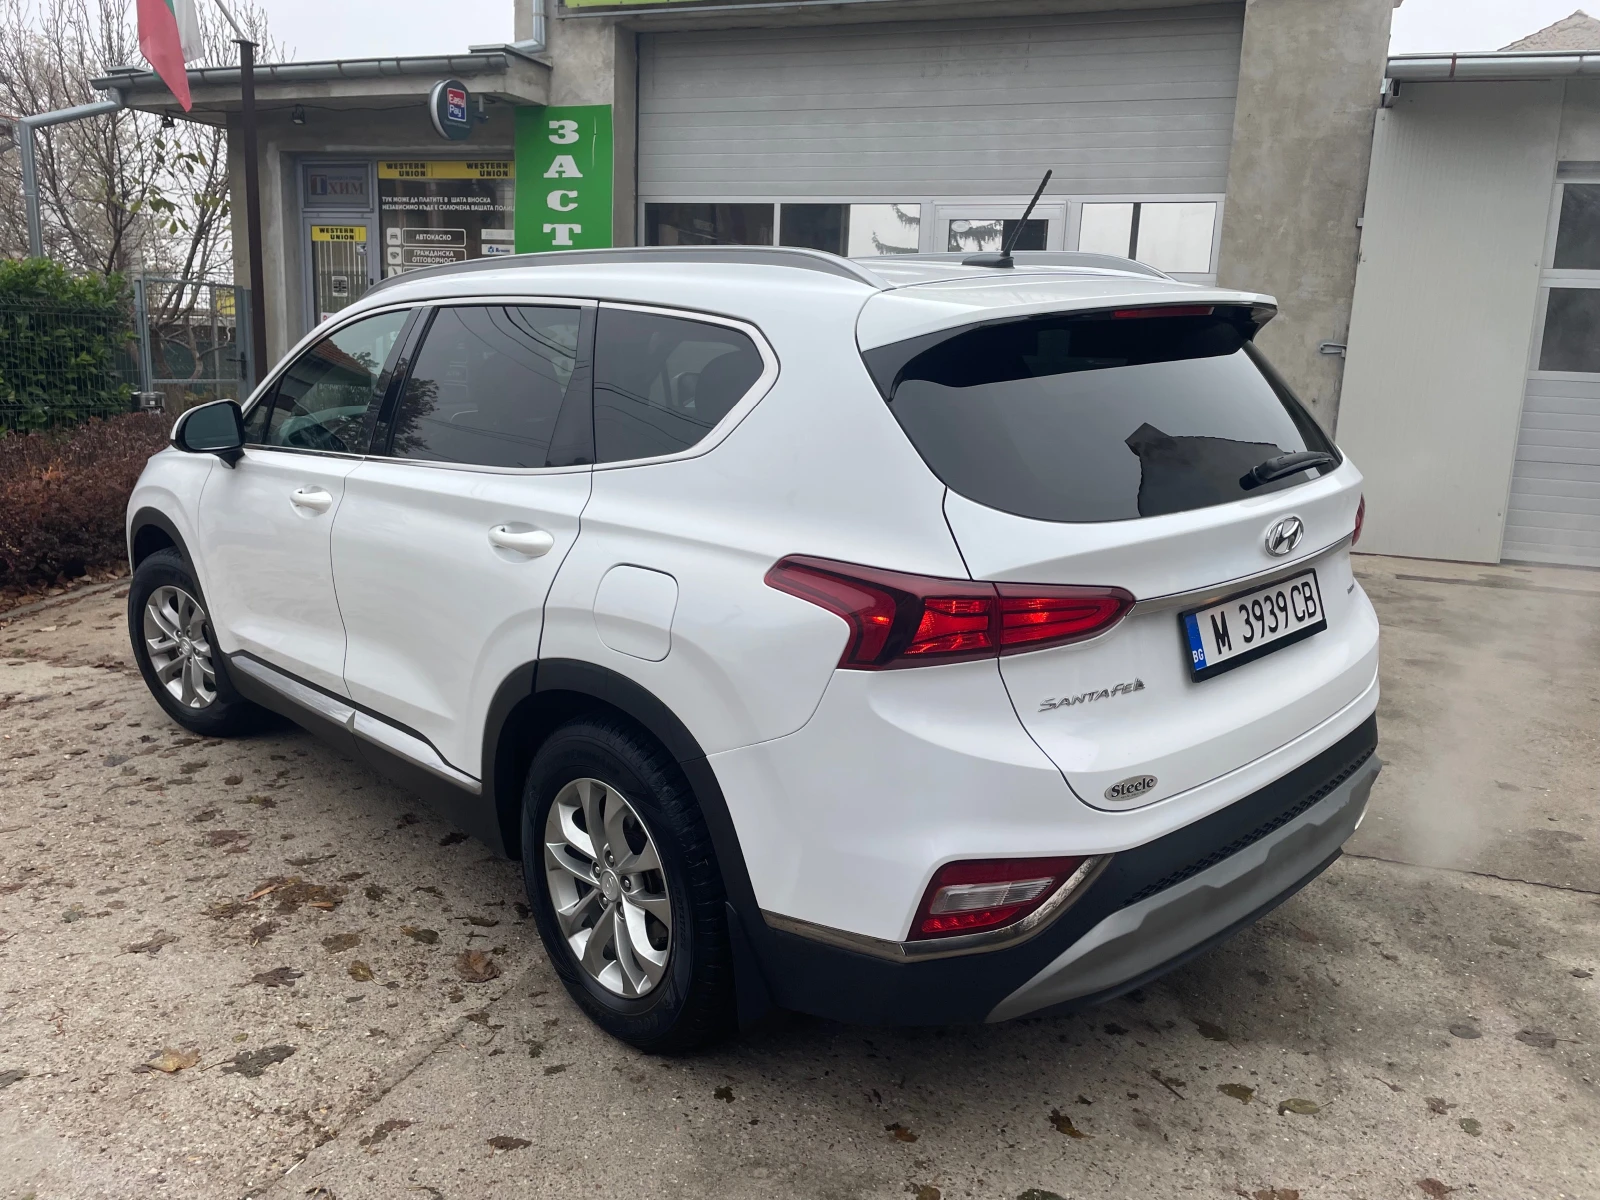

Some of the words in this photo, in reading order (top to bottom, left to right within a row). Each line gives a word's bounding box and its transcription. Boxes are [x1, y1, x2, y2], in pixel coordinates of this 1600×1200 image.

[449, 93, 465, 108] Easy
[450, 104, 462, 118] Pay
[386, 162, 426, 170] WESTERN
[466, 162, 508, 170] WESTERN
[410, 196, 418, 204] ДА
[415, 233, 452, 241] АВТОКАСКО
[1210, 610, 1233, 656] M
[1192, 648, 1204, 663] BG
[1111, 777, 1154, 798] Steele
